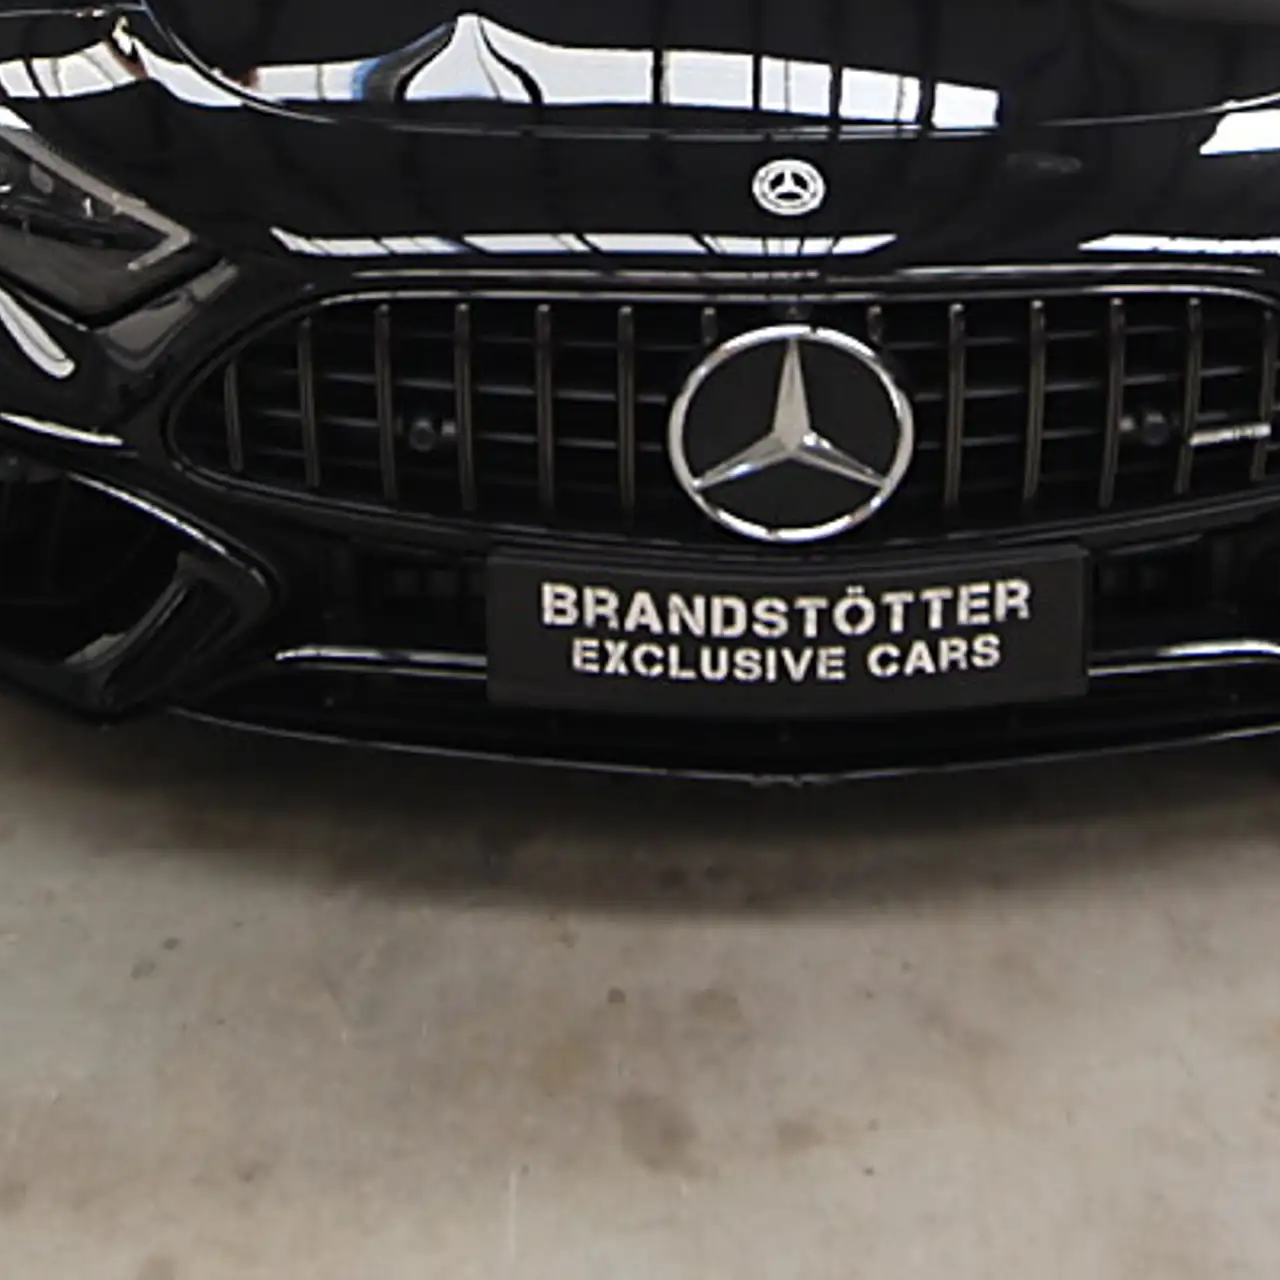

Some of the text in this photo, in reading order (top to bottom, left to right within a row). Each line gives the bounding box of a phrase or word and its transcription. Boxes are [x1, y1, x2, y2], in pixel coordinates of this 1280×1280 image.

[541, 579, 1031, 638] BRANDSTÖTTER
[572, 633, 1001, 682] EXCLUSIVE CARS
